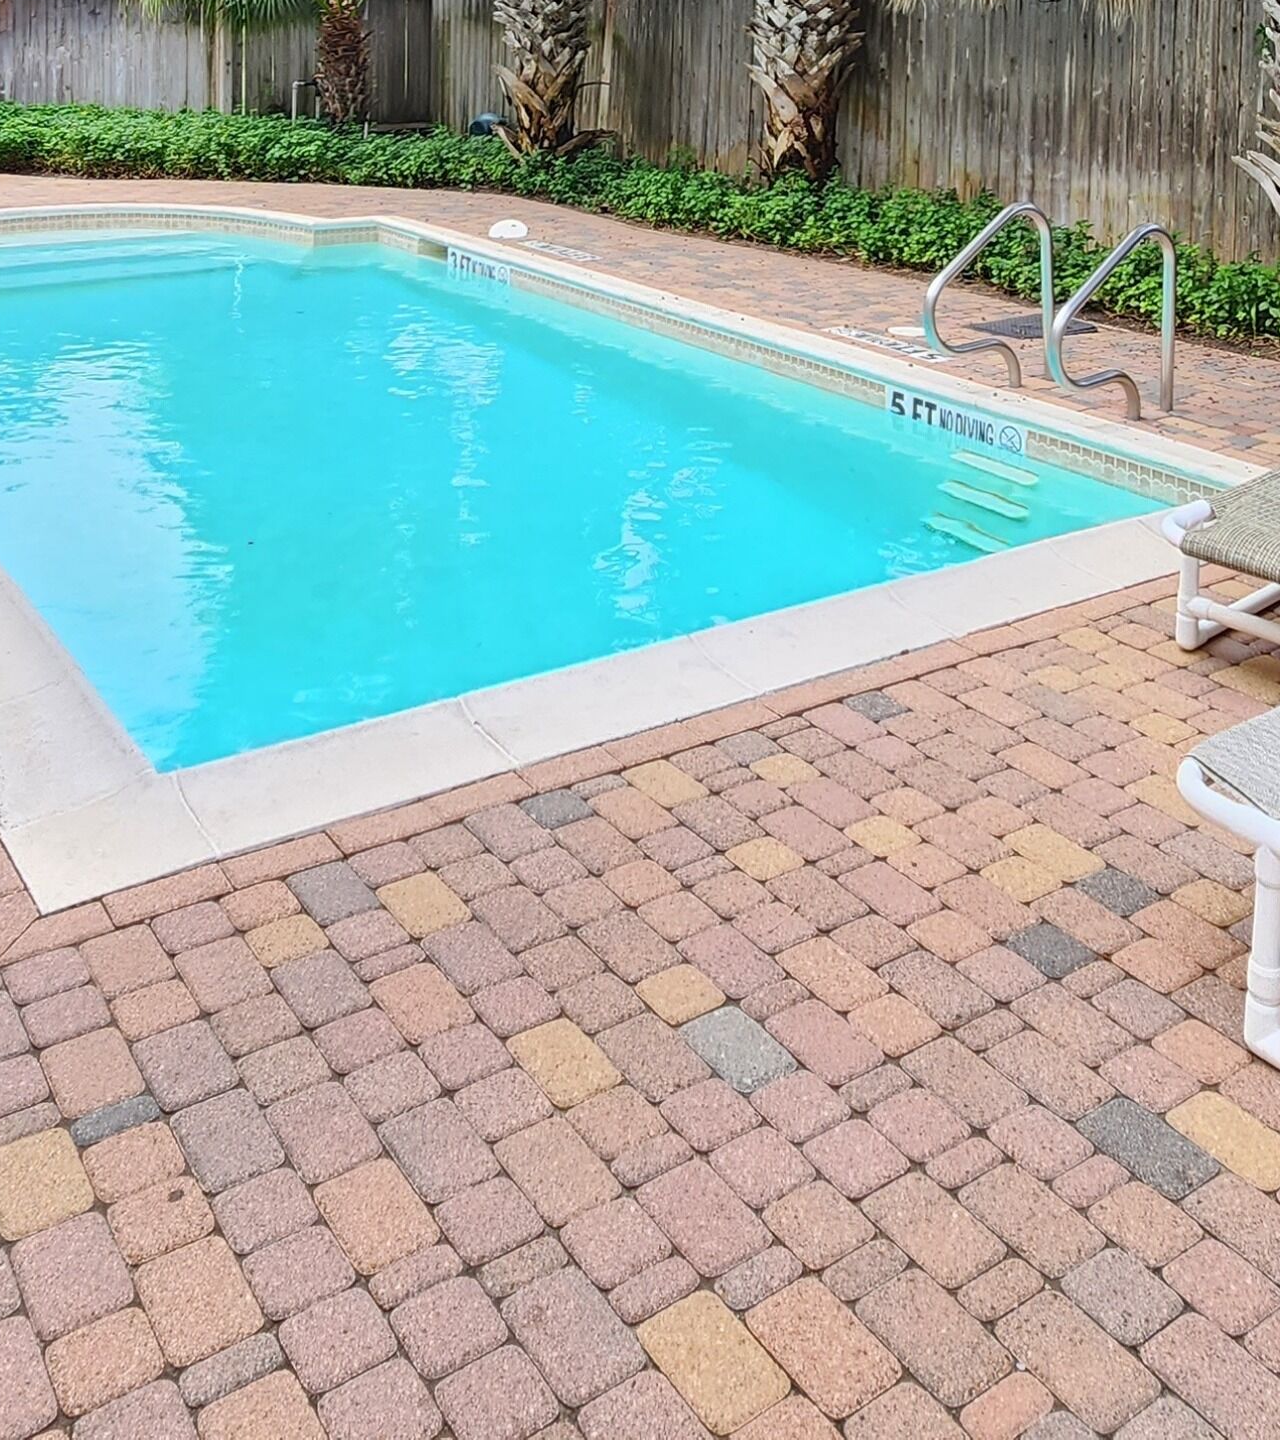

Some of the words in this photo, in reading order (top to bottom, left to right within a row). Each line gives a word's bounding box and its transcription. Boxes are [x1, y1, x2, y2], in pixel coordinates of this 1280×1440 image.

[890, 391, 906, 416] 5
[912, 397, 937, 426] FT
[939, 407, 954, 432] NO
[955, 413, 995, 446] DIVING
